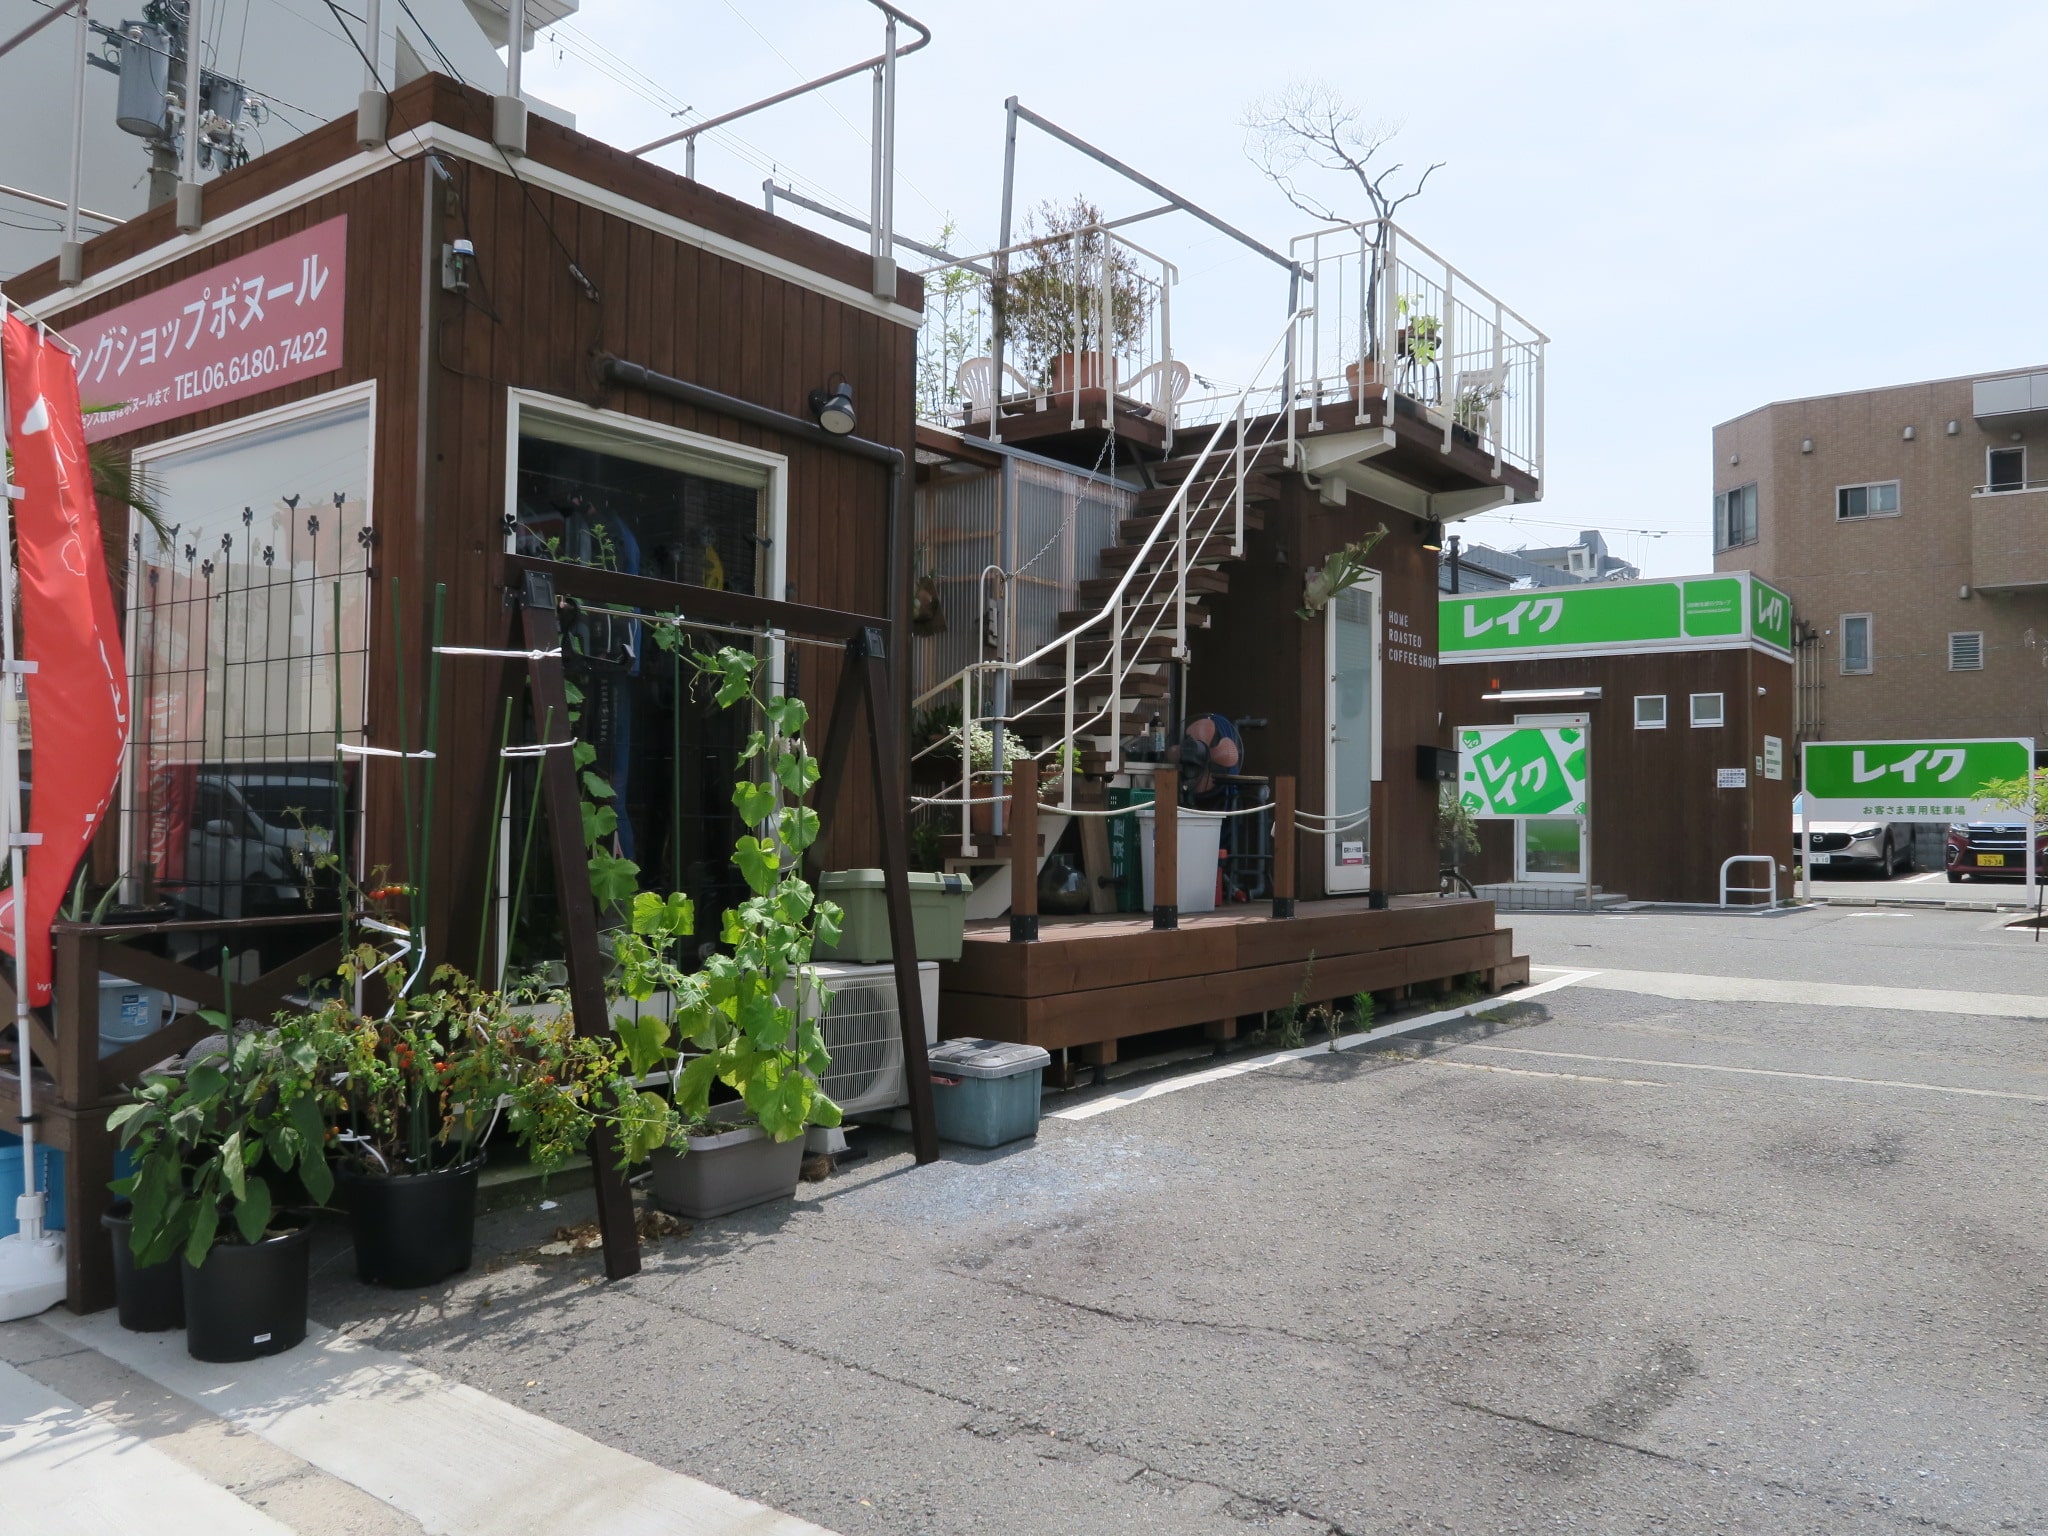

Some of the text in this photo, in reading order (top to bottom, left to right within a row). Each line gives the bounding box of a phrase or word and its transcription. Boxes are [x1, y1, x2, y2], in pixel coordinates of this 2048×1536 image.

[1388, 610, 1409, 628] HOME
[1463, 597, 1564, 638] レイク
[1758, 588, 1782, 632] レイク
[1388, 628, 1422, 648] ROASTED
[1480, 754, 1548, 807] レイク
[1852, 748, 1966, 783] レイク
[1862, 805, 1966, 816] お客さま専用駐車場
